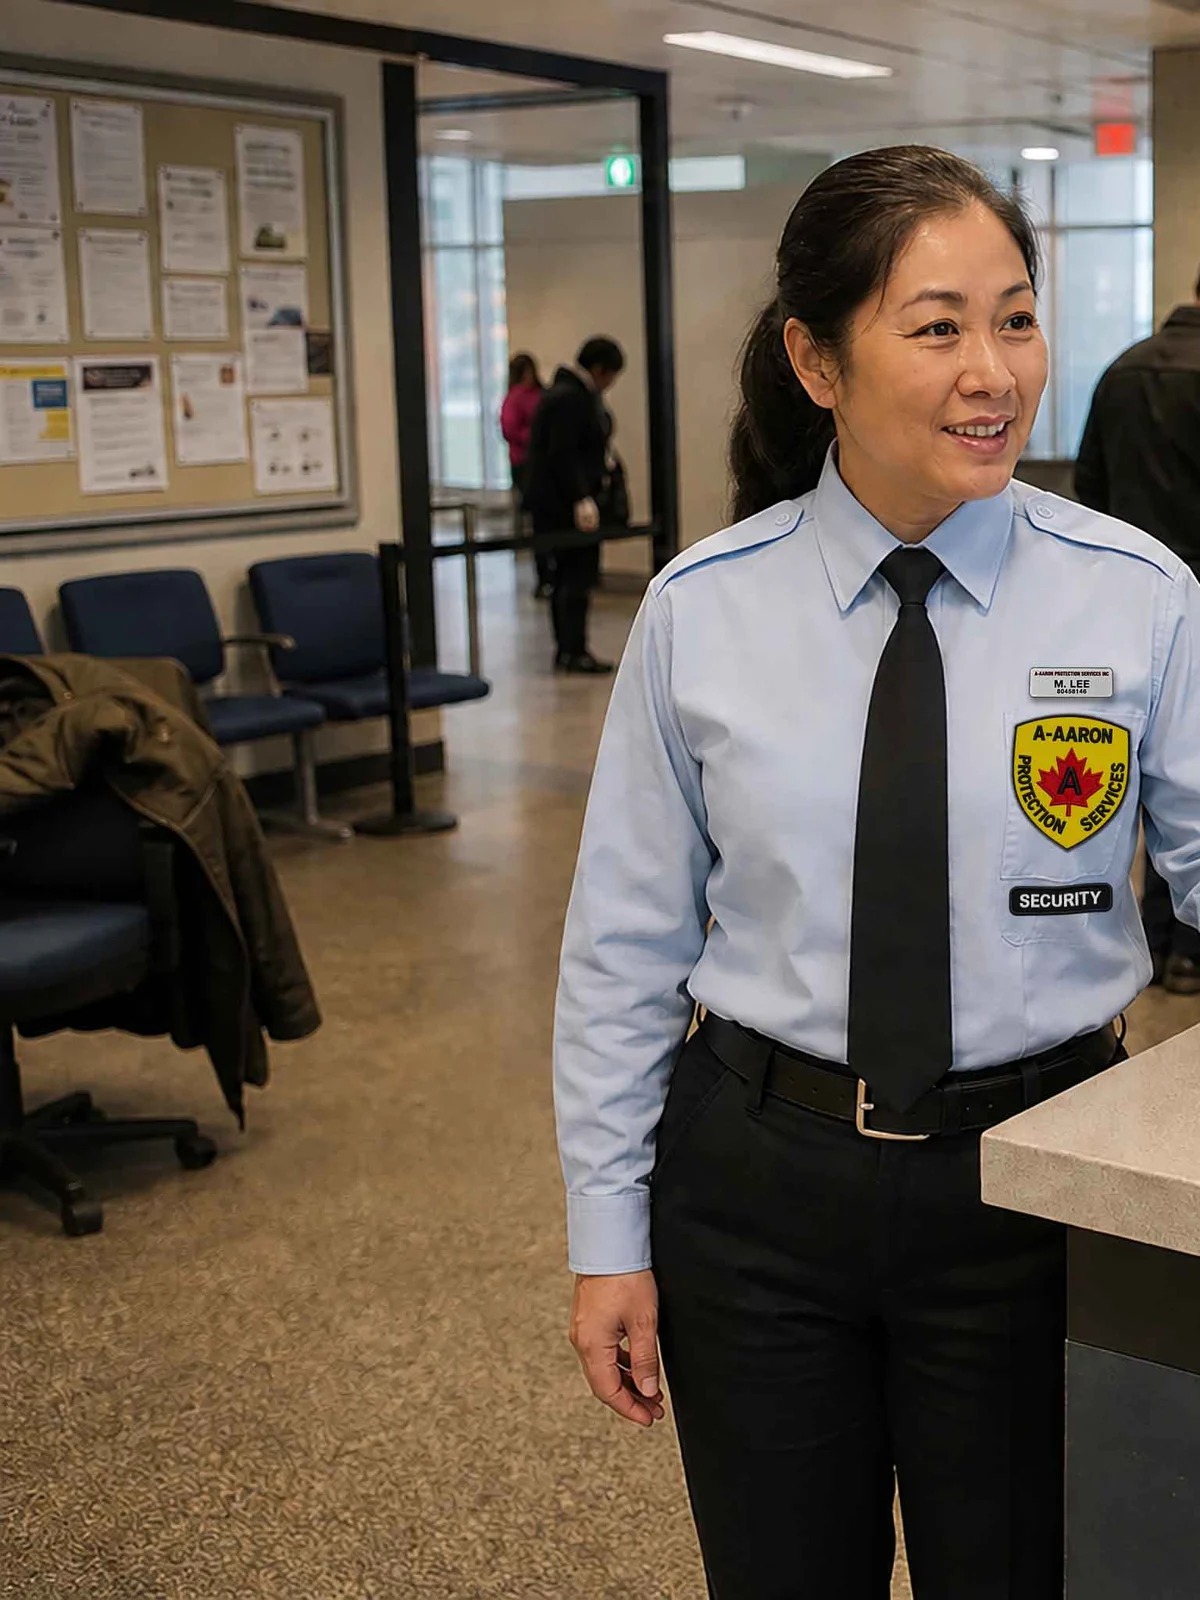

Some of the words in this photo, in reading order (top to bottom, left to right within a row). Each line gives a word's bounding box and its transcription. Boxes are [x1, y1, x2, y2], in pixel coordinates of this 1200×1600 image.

[1054, 680, 1066, 688] M.
[1070, 680, 1090, 688] LEE
[1032, 725, 1113, 744] A-AARON
[1056, 766, 1082, 796] A
[1017, 754, 1066, 834] PROTECTION
[1080, 762, 1125, 832] SERVICES
[1019, 890, 1102, 908] SECURITY
